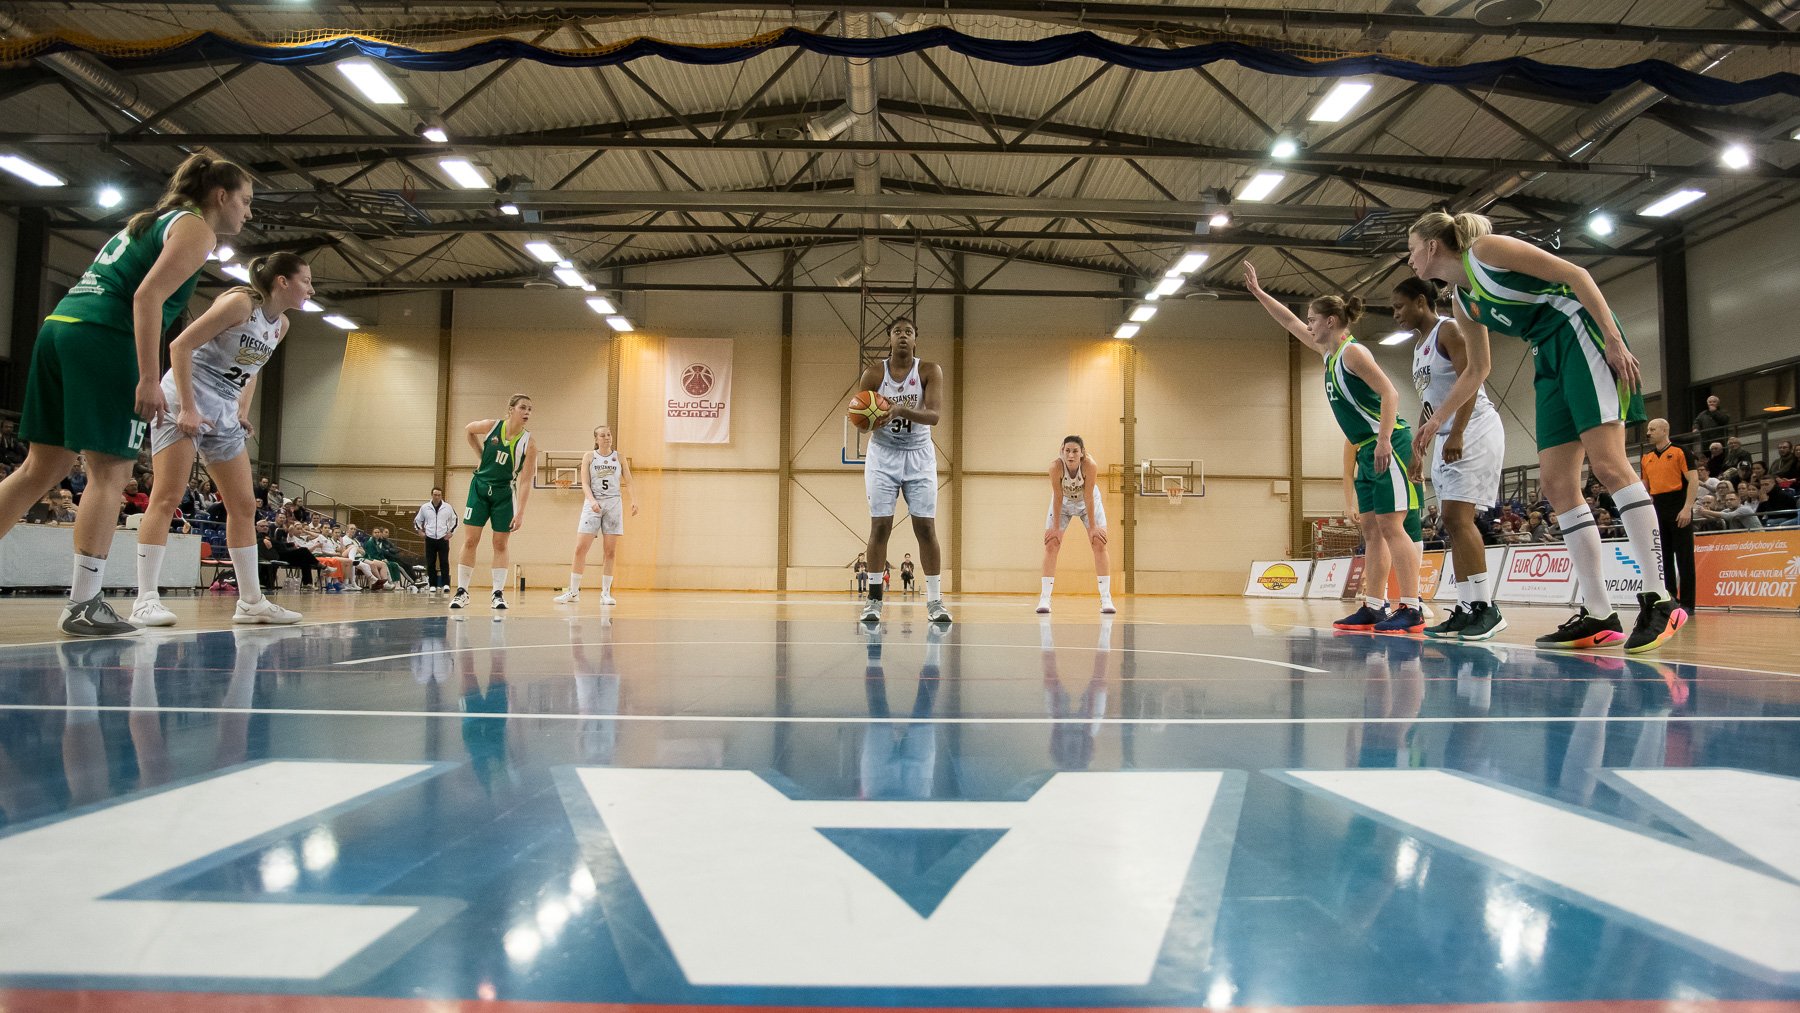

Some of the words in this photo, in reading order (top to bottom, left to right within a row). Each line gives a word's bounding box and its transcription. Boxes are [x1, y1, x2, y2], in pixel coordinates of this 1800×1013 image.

[667, 399, 726, 410] EuroCup
[668, 410, 719, 418] women
[890, 418, 912, 433] 34
[128, 418, 147, 450] 15
[495, 450, 509, 466] 10
[601, 479, 609, 491] 5
[1713, 581, 1797, 597] SLOVKURORT
